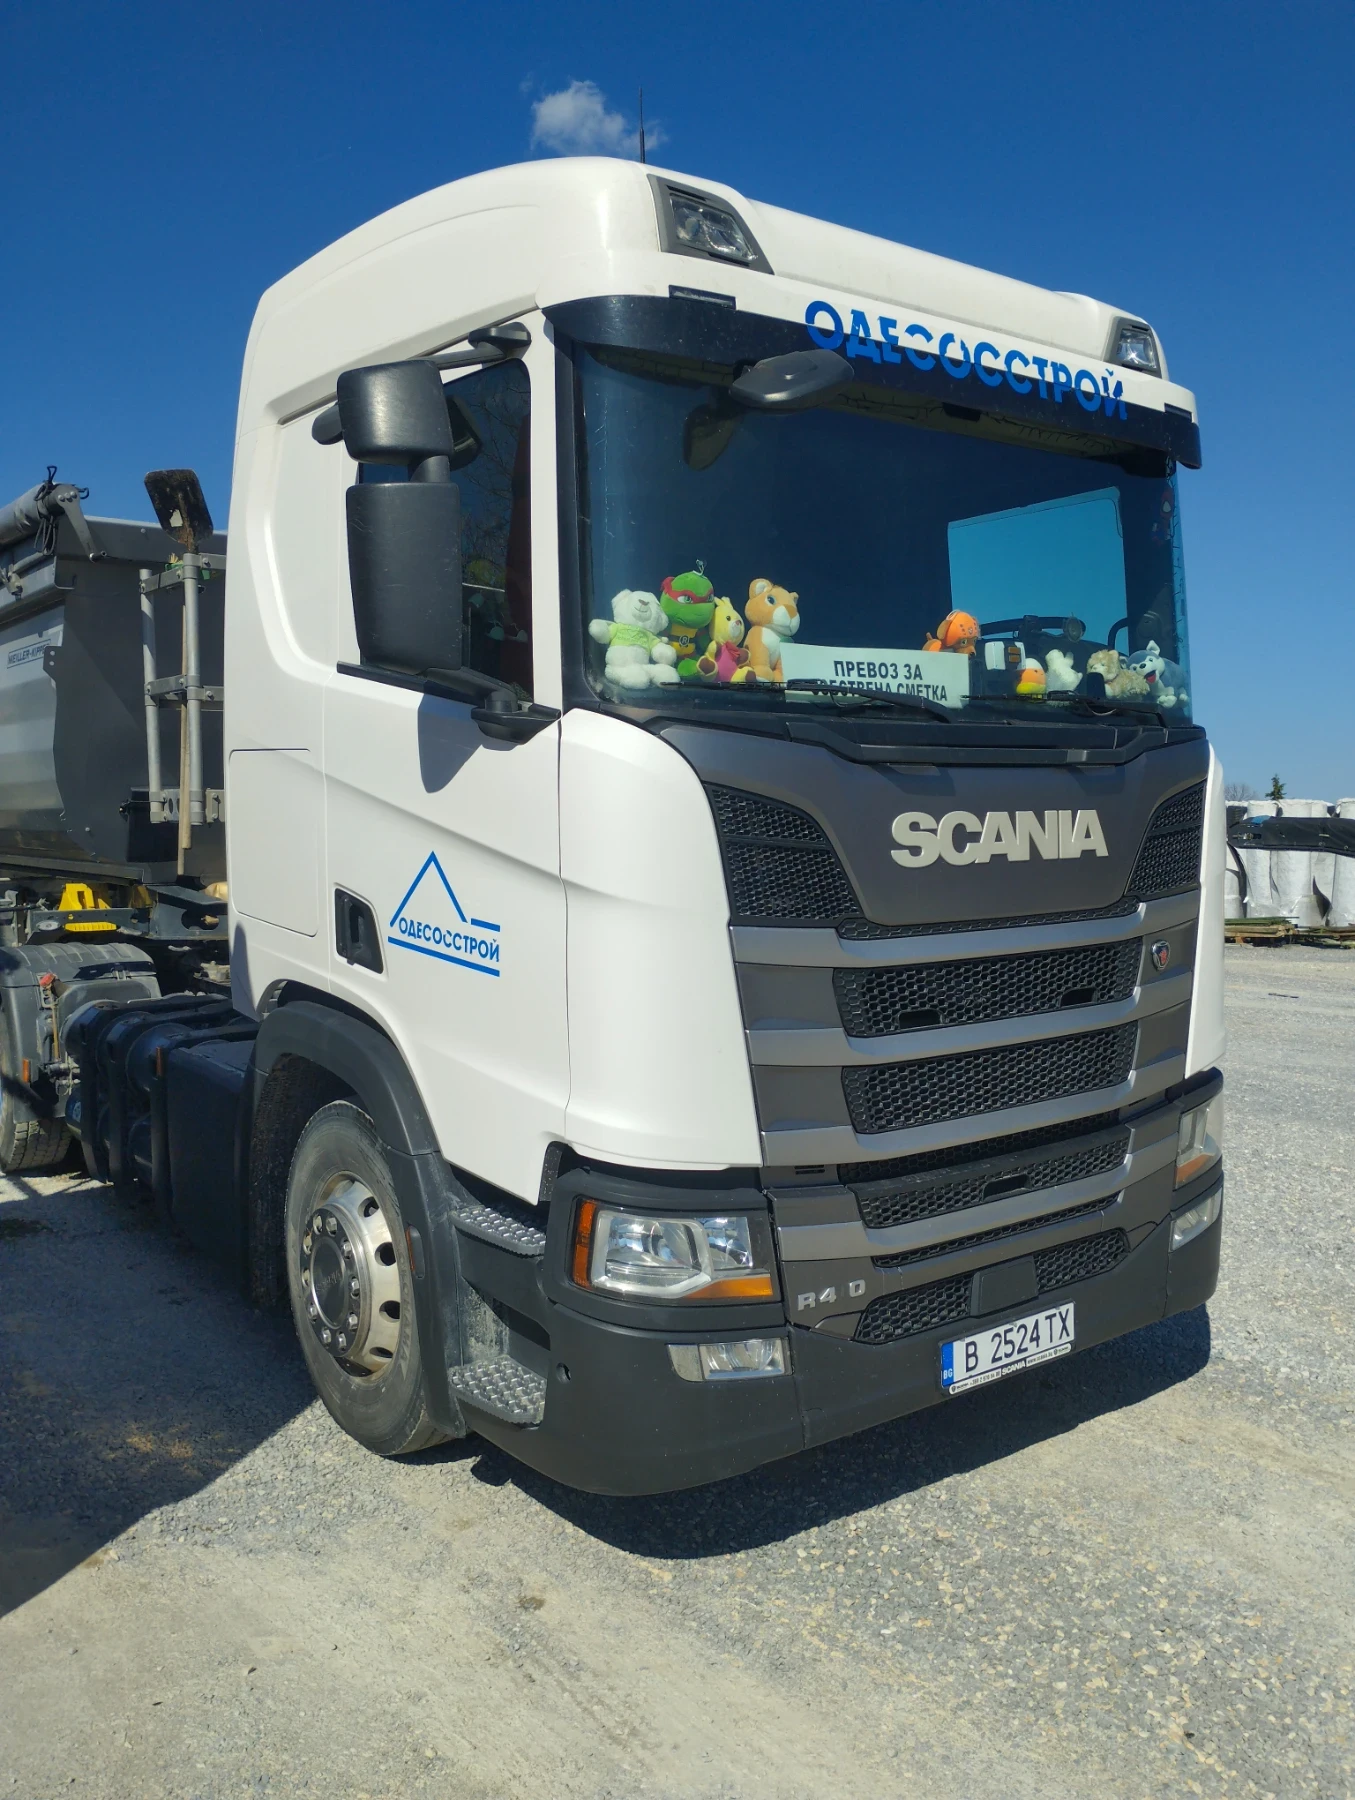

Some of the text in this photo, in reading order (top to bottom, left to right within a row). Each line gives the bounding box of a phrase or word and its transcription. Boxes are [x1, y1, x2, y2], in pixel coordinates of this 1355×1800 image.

[805, 300, 1127, 420] ОДЕСОССТРОЙ
[833, 660, 923, 681] ПРЕВОЗ ЗА
[897, 682, 948, 701] СМЕТКА
[890, 809, 1109, 868] SCANIA
[398, 917, 500, 962] ОДЕСОССТРОЙ
[991, 1318, 1041, 1364] 2524
[1045, 1308, 1071, 1344] TX
[943, 1368, 953, 1380] BG
[1002, 1360, 1026, 1375] SCANIA
